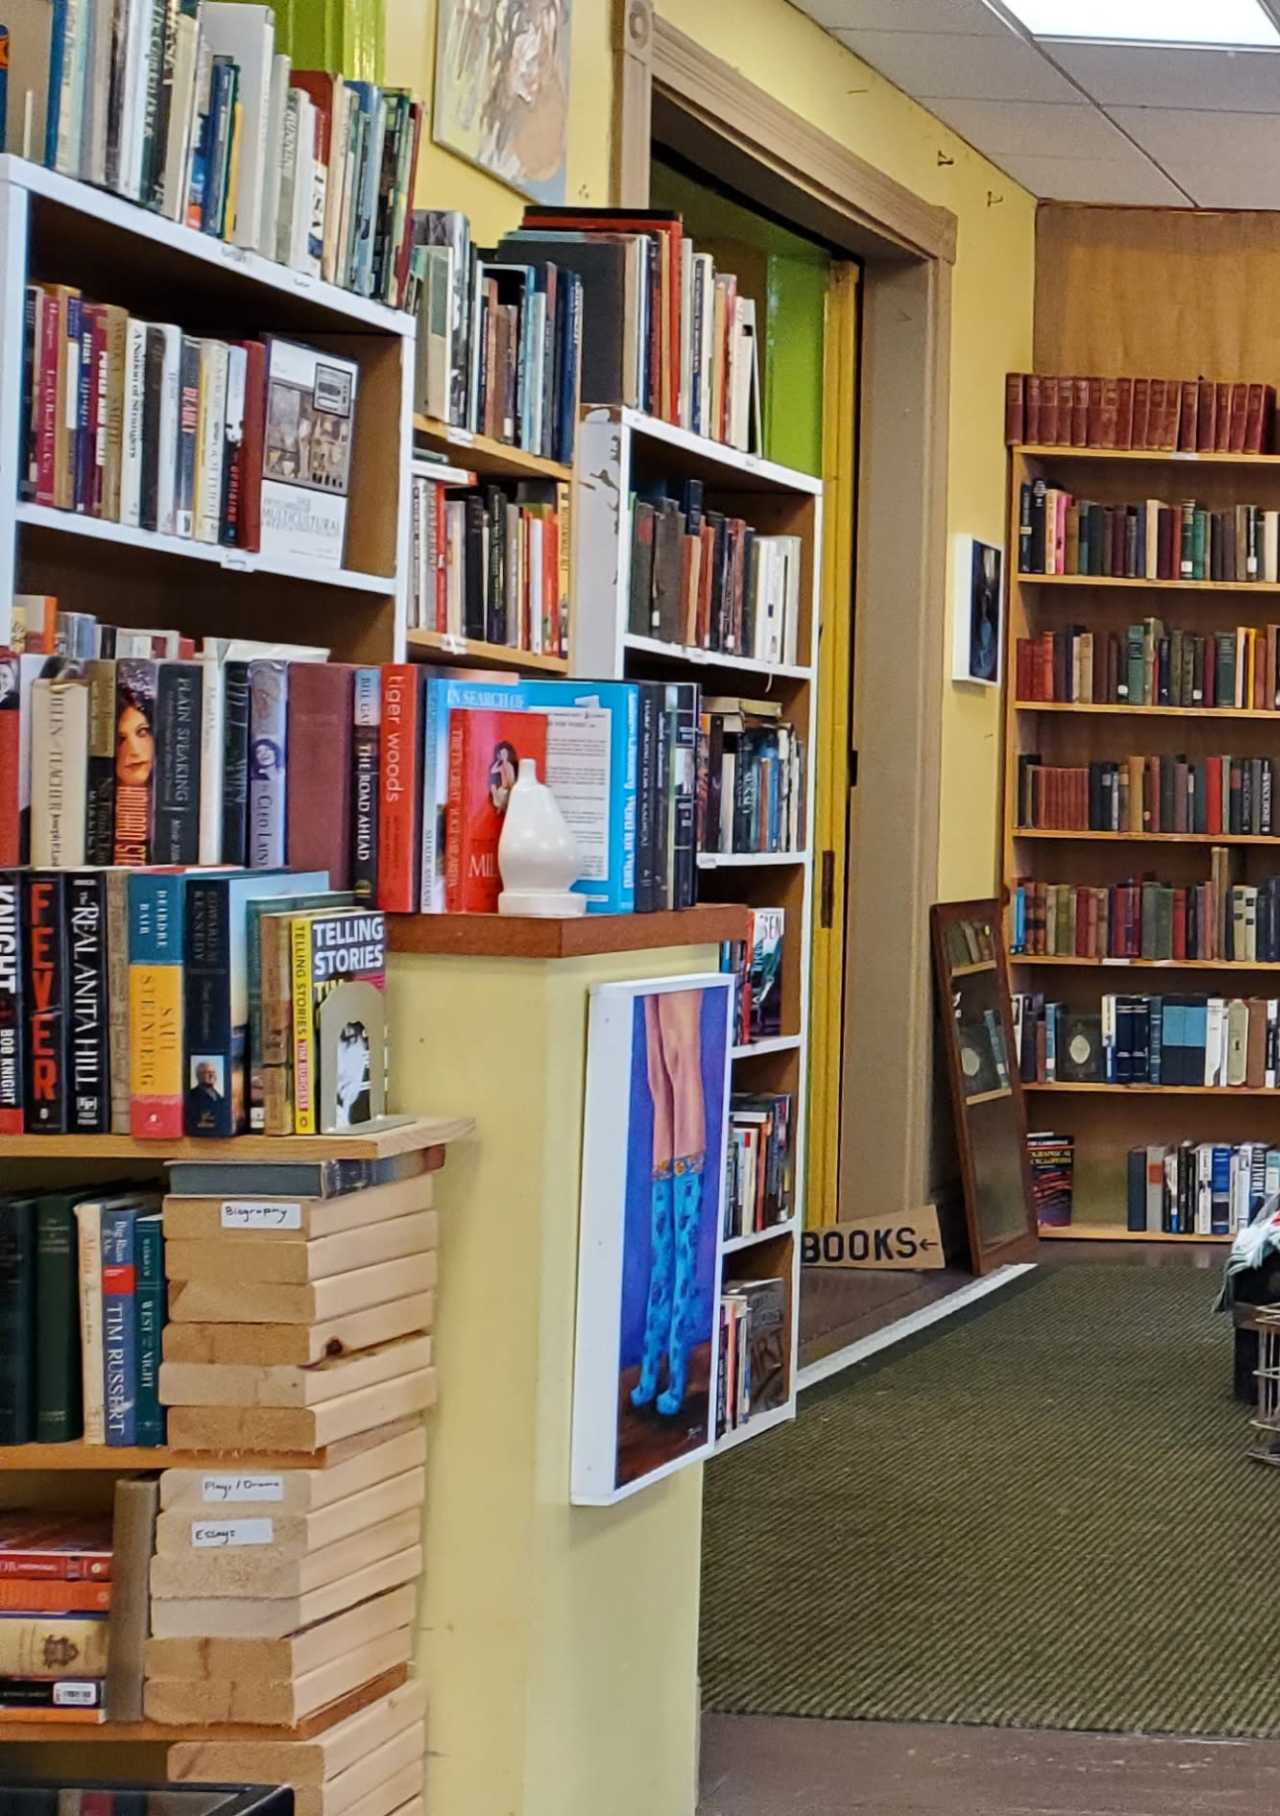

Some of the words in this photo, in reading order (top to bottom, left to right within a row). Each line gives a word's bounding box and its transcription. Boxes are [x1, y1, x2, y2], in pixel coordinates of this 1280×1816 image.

[177, 677, 191, 723] PLAIN
[387, 675, 404, 722] tiger
[174, 729, 191, 802] SPEAKING
[358, 744, 372, 768] THE
[385, 732, 404, 803] woods
[358, 773, 372, 813] ROAD
[358, 815, 372, 861] AHEAD
[0, 884, 16, 994] KNIGHT
[72, 903, 99, 960] REAL
[139, 903, 150, 936] BAIR
[156, 890, 168, 948] DEIRDRE
[312, 917, 384, 947] TELLING
[294, 926, 306, 979] TELLING
[313, 944, 385, 976] STORIES
[31, 882, 58, 1101] FEVER
[73, 962, 98, 1033] ANITA
[295, 983, 307, 1041] STORIES
[0, 1029, 15, 1055] BOB
[140, 975, 157, 1086] STEINBERG
[159, 1006, 176, 1050] SAUL
[0, 1058, 15, 1105] KNIGHT
[73, 1038, 98, 1092] HILL
[801, 1227, 917, 1264] BOOKS
[106, 1303, 123, 1341] TIM
[141, 1300, 153, 1333] WEST
[108, 1348, 125, 1436] RUSSERT
[141, 1350, 153, 1388] NIGHT
